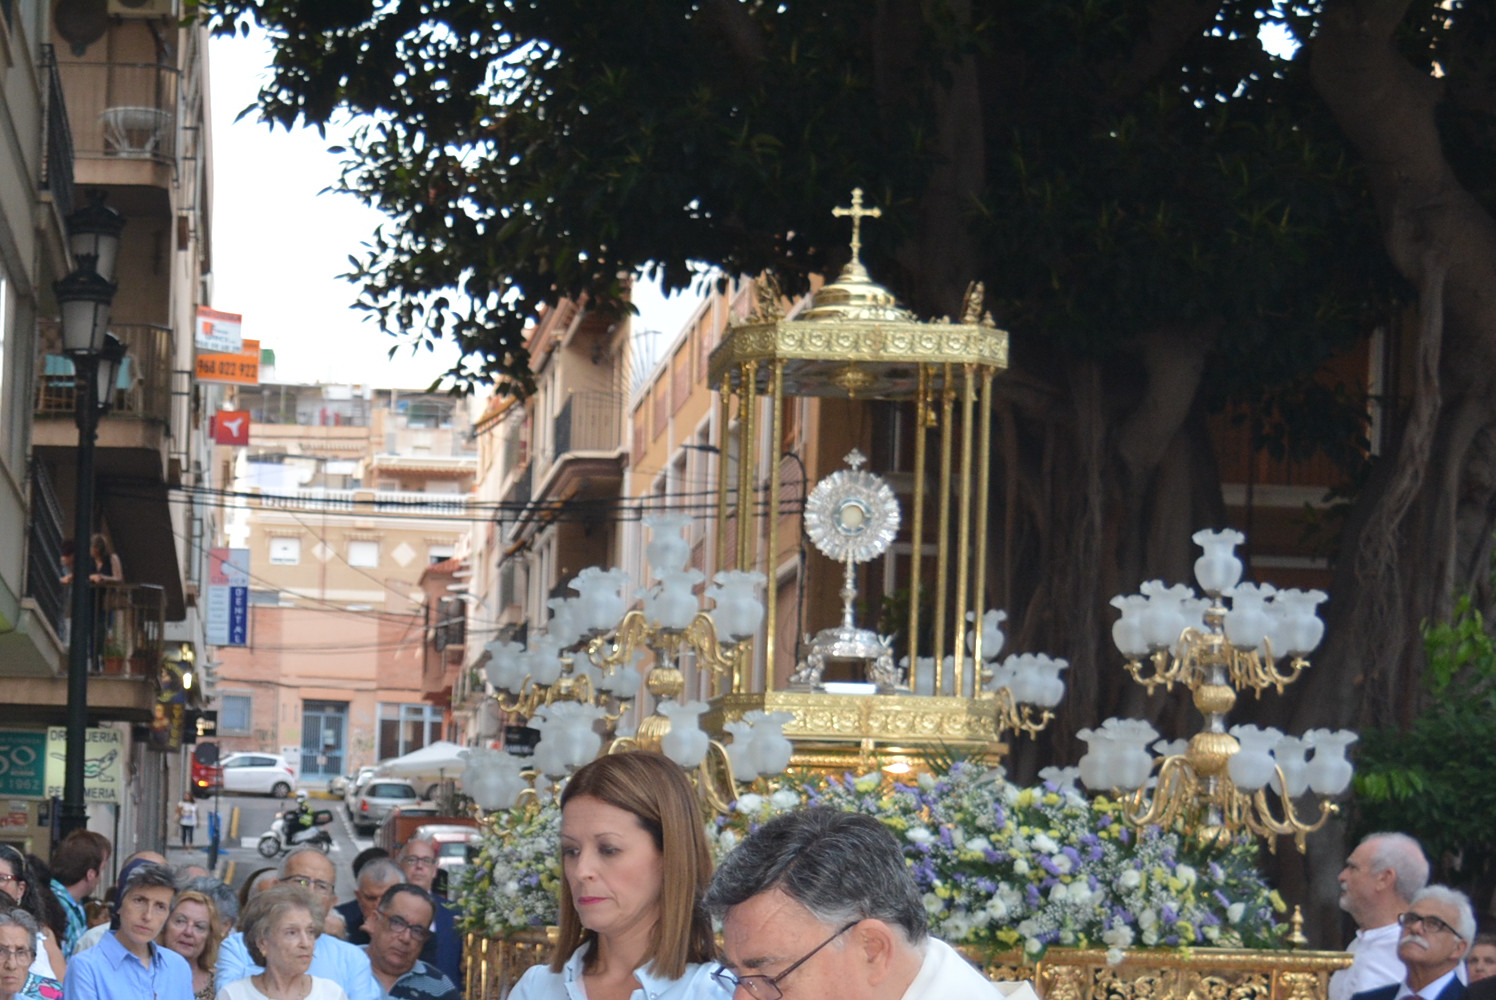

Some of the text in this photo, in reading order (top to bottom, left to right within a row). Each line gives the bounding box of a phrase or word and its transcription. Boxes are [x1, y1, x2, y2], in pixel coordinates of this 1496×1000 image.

[219, 361, 236, 377] 022
[239, 363, 257, 379] 922
[233, 588, 244, 644] DENTAL
[9, 779, 41, 791] 1962
[48, 785, 116, 798] PEMERIA
